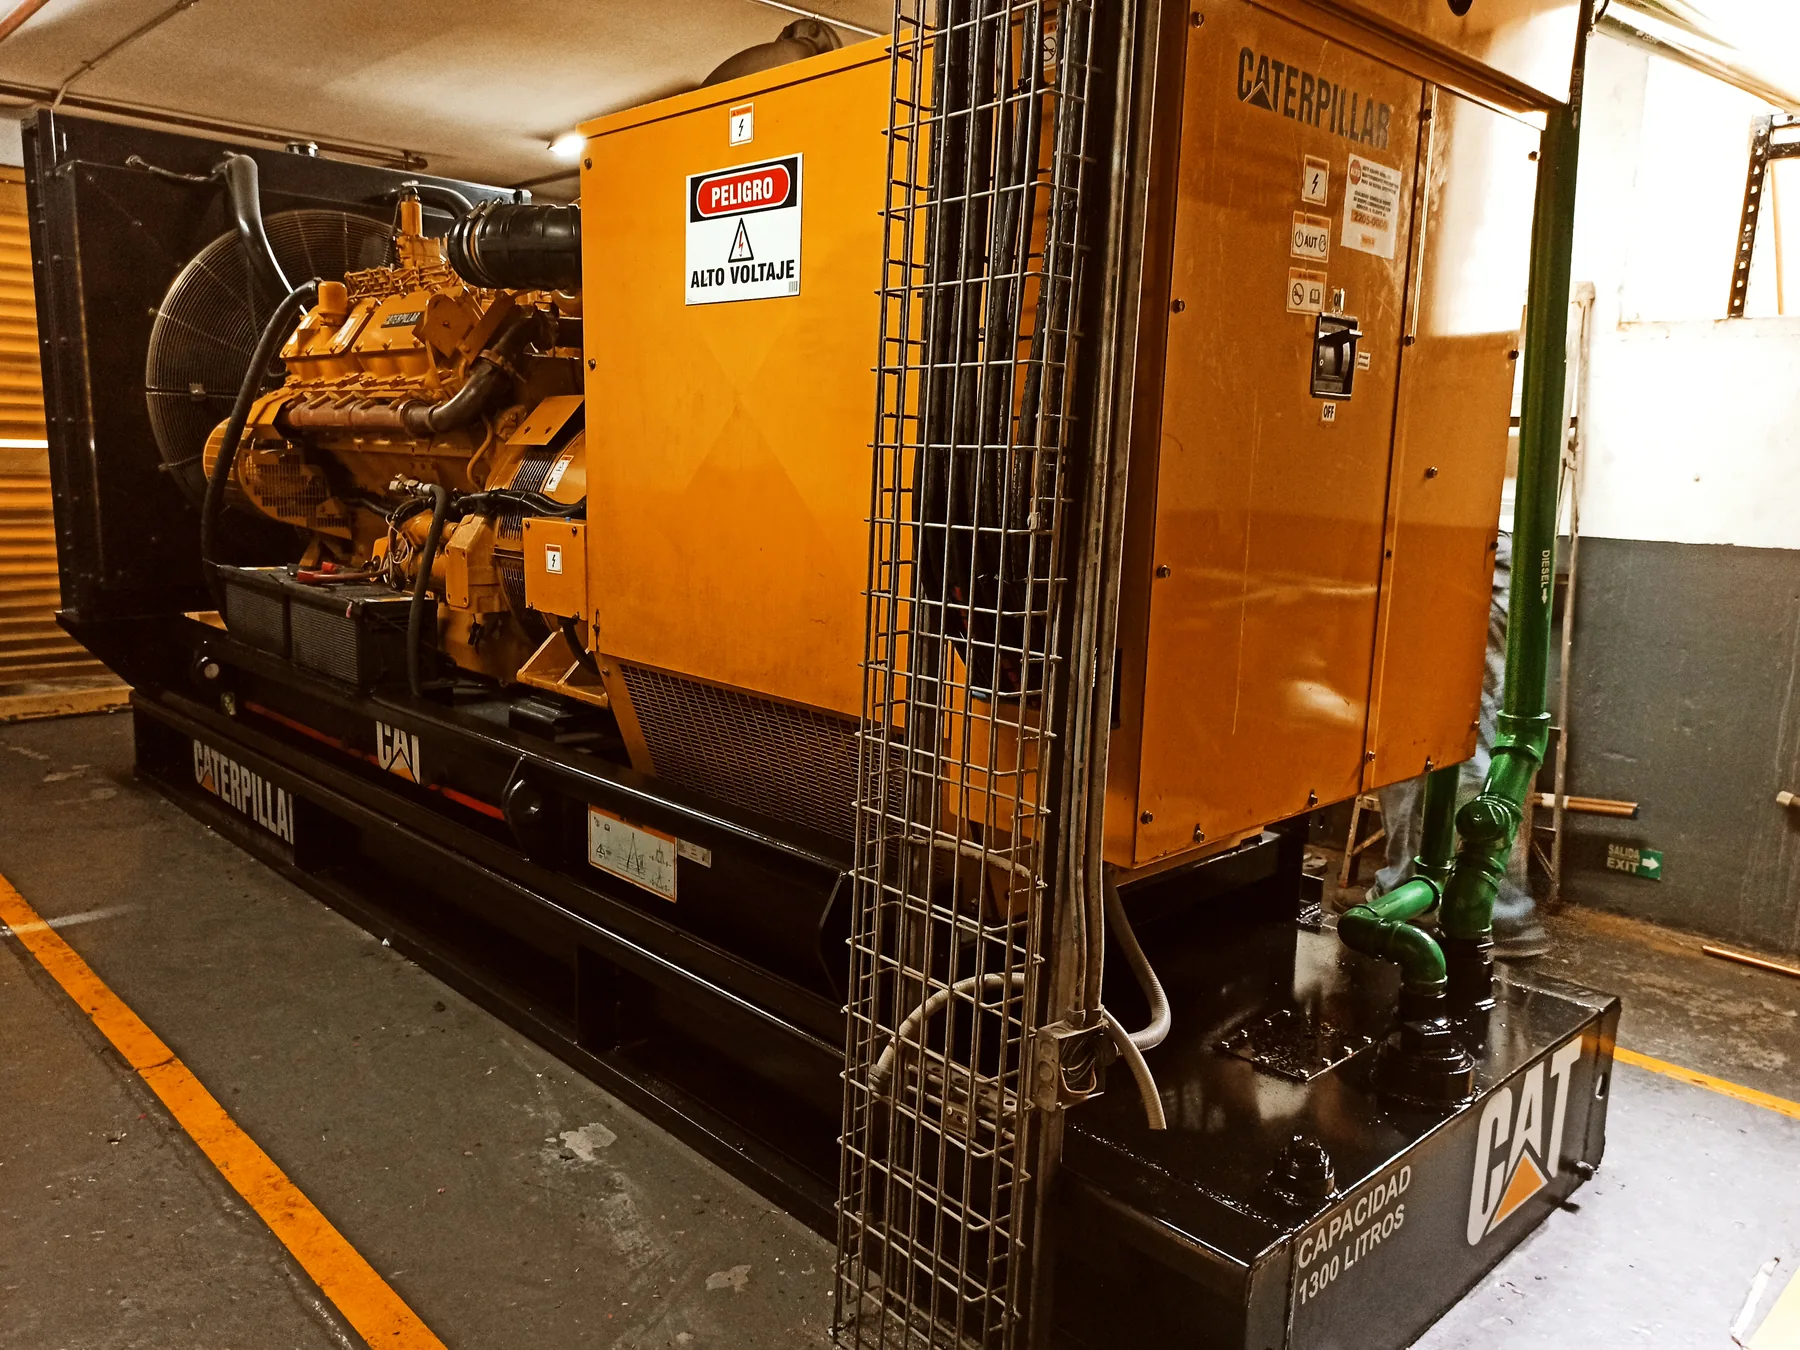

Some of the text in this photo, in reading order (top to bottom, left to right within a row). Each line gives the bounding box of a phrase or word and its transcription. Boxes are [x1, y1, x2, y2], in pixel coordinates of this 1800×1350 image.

[1237, 46, 1392, 150] CATERPILLAR
[1571, 67, 1584, 111] DIESEL
[711, 176, 773, 208] PELIGRO
[690, 259, 795, 289] ALTO VOLTAJE
[1323, 404, 1335, 419] OFF
[1541, 550, 1551, 588] DIESEL
[1607, 857, 1639, 873] EXIT
[1608, 844, 1640, 860] SALIDA
[1466, 1035, 1583, 1246] CAT
[1298, 1165, 1411, 1269] CAPACIDAD
[1299, 1203, 1405, 1305] 1300 LITROS
